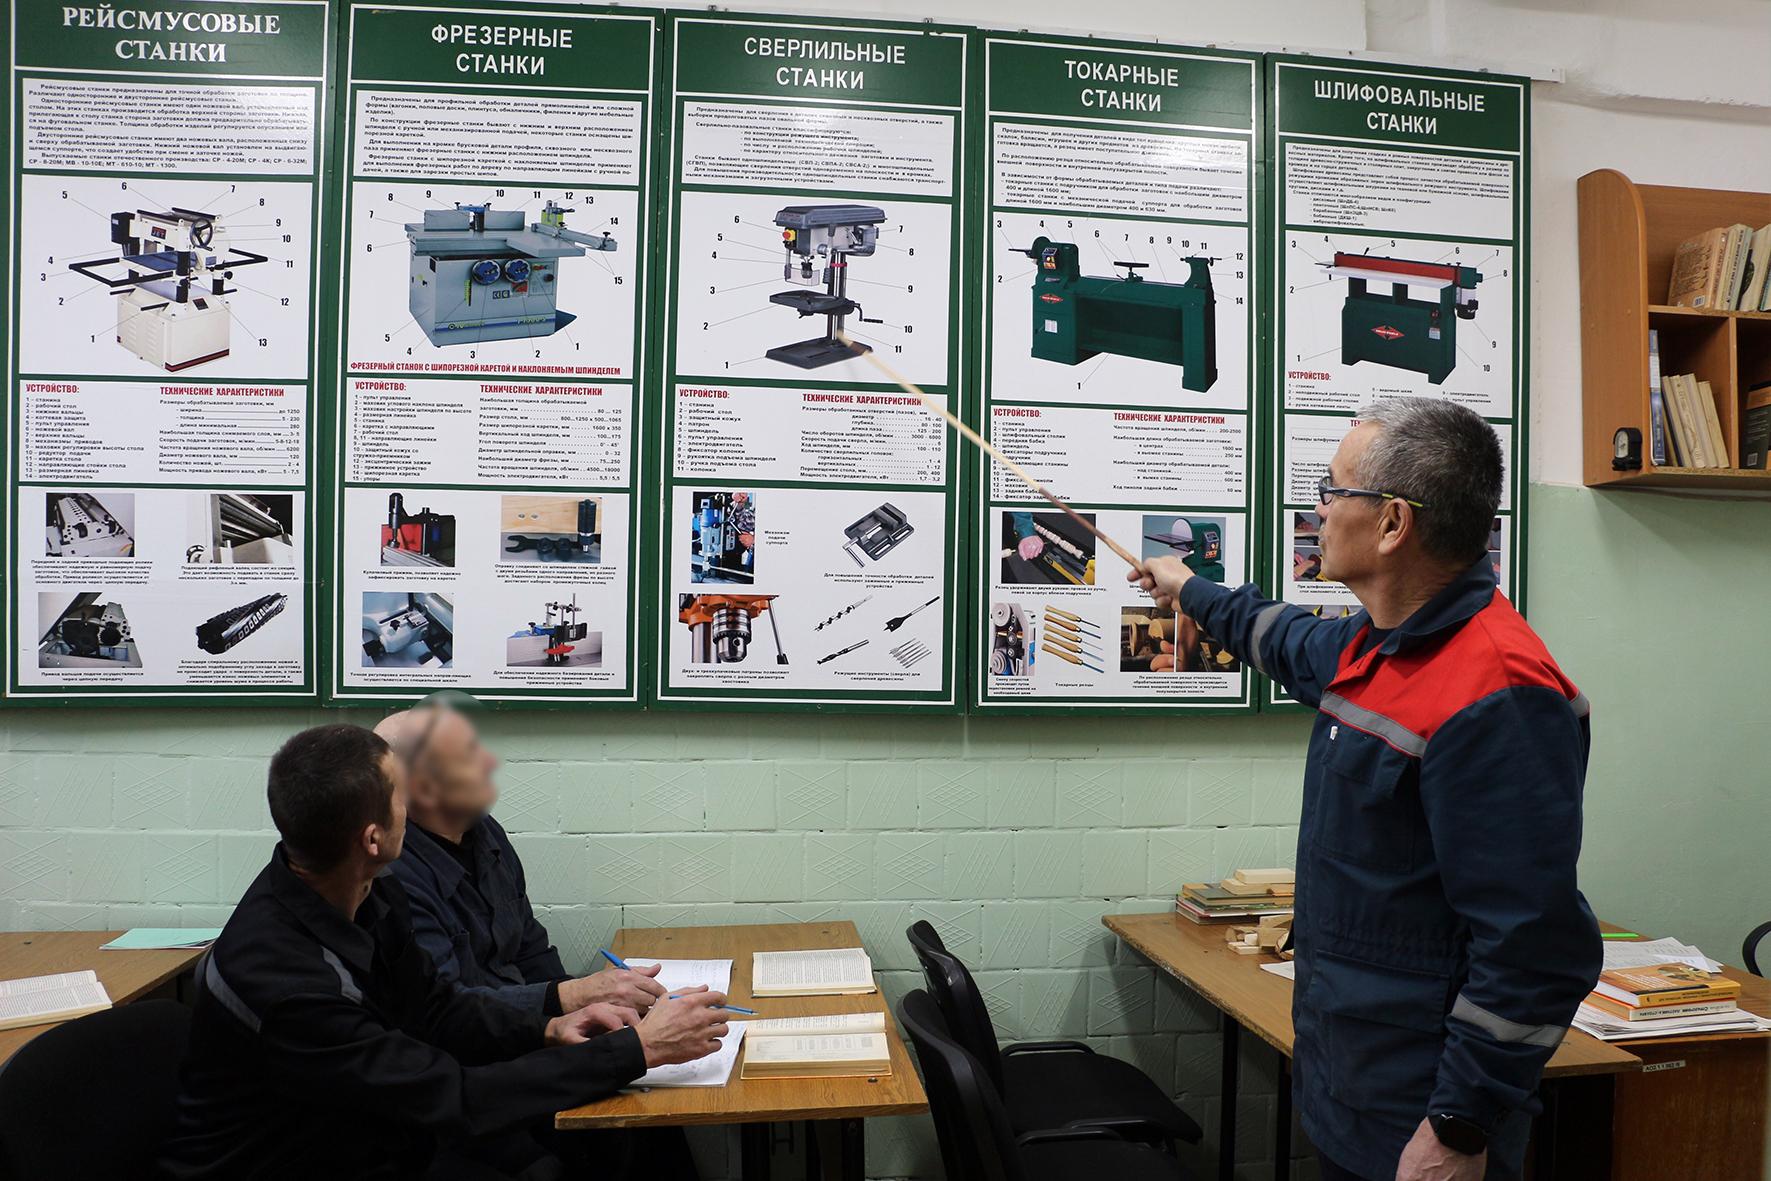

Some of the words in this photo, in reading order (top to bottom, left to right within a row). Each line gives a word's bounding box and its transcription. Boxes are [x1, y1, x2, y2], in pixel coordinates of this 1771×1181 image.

[63, 4, 280, 34] РЕЙСМУСОВЫЕ
[432, 24, 572, 48] ФРЕЗЕРНЫЕ
[116, 40, 226, 62] СТАНКИ
[745, 37, 905, 64] СВЕРЛИЛЬНЫЕ
[456, 53, 544, 75] СТАНКИ
[777, 67, 863, 89] СТАНКИ
[1064, 60, 1178, 87] ТОКАРНЫЕ
[1315, 78, 1487, 112] ШЛИФОВАЛЬНЫЕ
[1082, 89, 1160, 112] СТАНКИ
[1367, 112, 1436, 134] СТАНКИ
[122, 182, 127, 190] 6
[388, 193, 393, 201] 8
[276, 218, 281, 227] 9
[997, 220, 1002, 228] 3
[367, 244, 372, 252] 6
[909, 248, 914, 256] 8
[41, 273, 46, 281] 3
[908, 285, 913, 293] 9
[281, 298, 289, 306] 12
[704, 322, 708, 330] 2
[259, 338, 267, 346] 13
[385, 334, 390, 342] 5
[470, 350, 475, 359] 3
[351, 362, 394, 371] ФРЕЗЕРНЫЙ
[431, 363, 479, 372] ШИПОРЕЗНОЙ
[480, 364, 510, 372] КАРЕТОЙ
[518, 365, 573, 374] НАКЛОНЯЕМЫМ
[575, 366, 620, 375] ШПИНДЕЛЕМ
[1288, 370, 1331, 381] УСТРОЙСТВО:
[26, 383, 79, 393] УСТРОЙСТВО:
[355, 381, 406, 390] УСТРОЙСТВО:
[160, 387, 213, 395] ТЕХНИЧЕСКИЕ
[217, 388, 284, 396] ХАРАКТЕРИСТИКИ
[480, 385, 532, 394] ТЕХНИЧЕСКИЕ
[536, 386, 602, 396] ХАРАКТЕРИСТИКИ
[680, 389, 730, 398] УСТРОЙСТВО:
[803, 394, 853, 403] ТЕХНИЧЕСКИЕ
[857, 396, 921, 405] ХАРАКТЕРИСТИКИ
[993, 408, 1041, 417] УСТРОЙСТВО:
[1114, 413, 1161, 422] ТЕХНИЧЕСКИЕ
[1164, 415, 1224, 424] ХАРАКТЕРИСТИКИ
